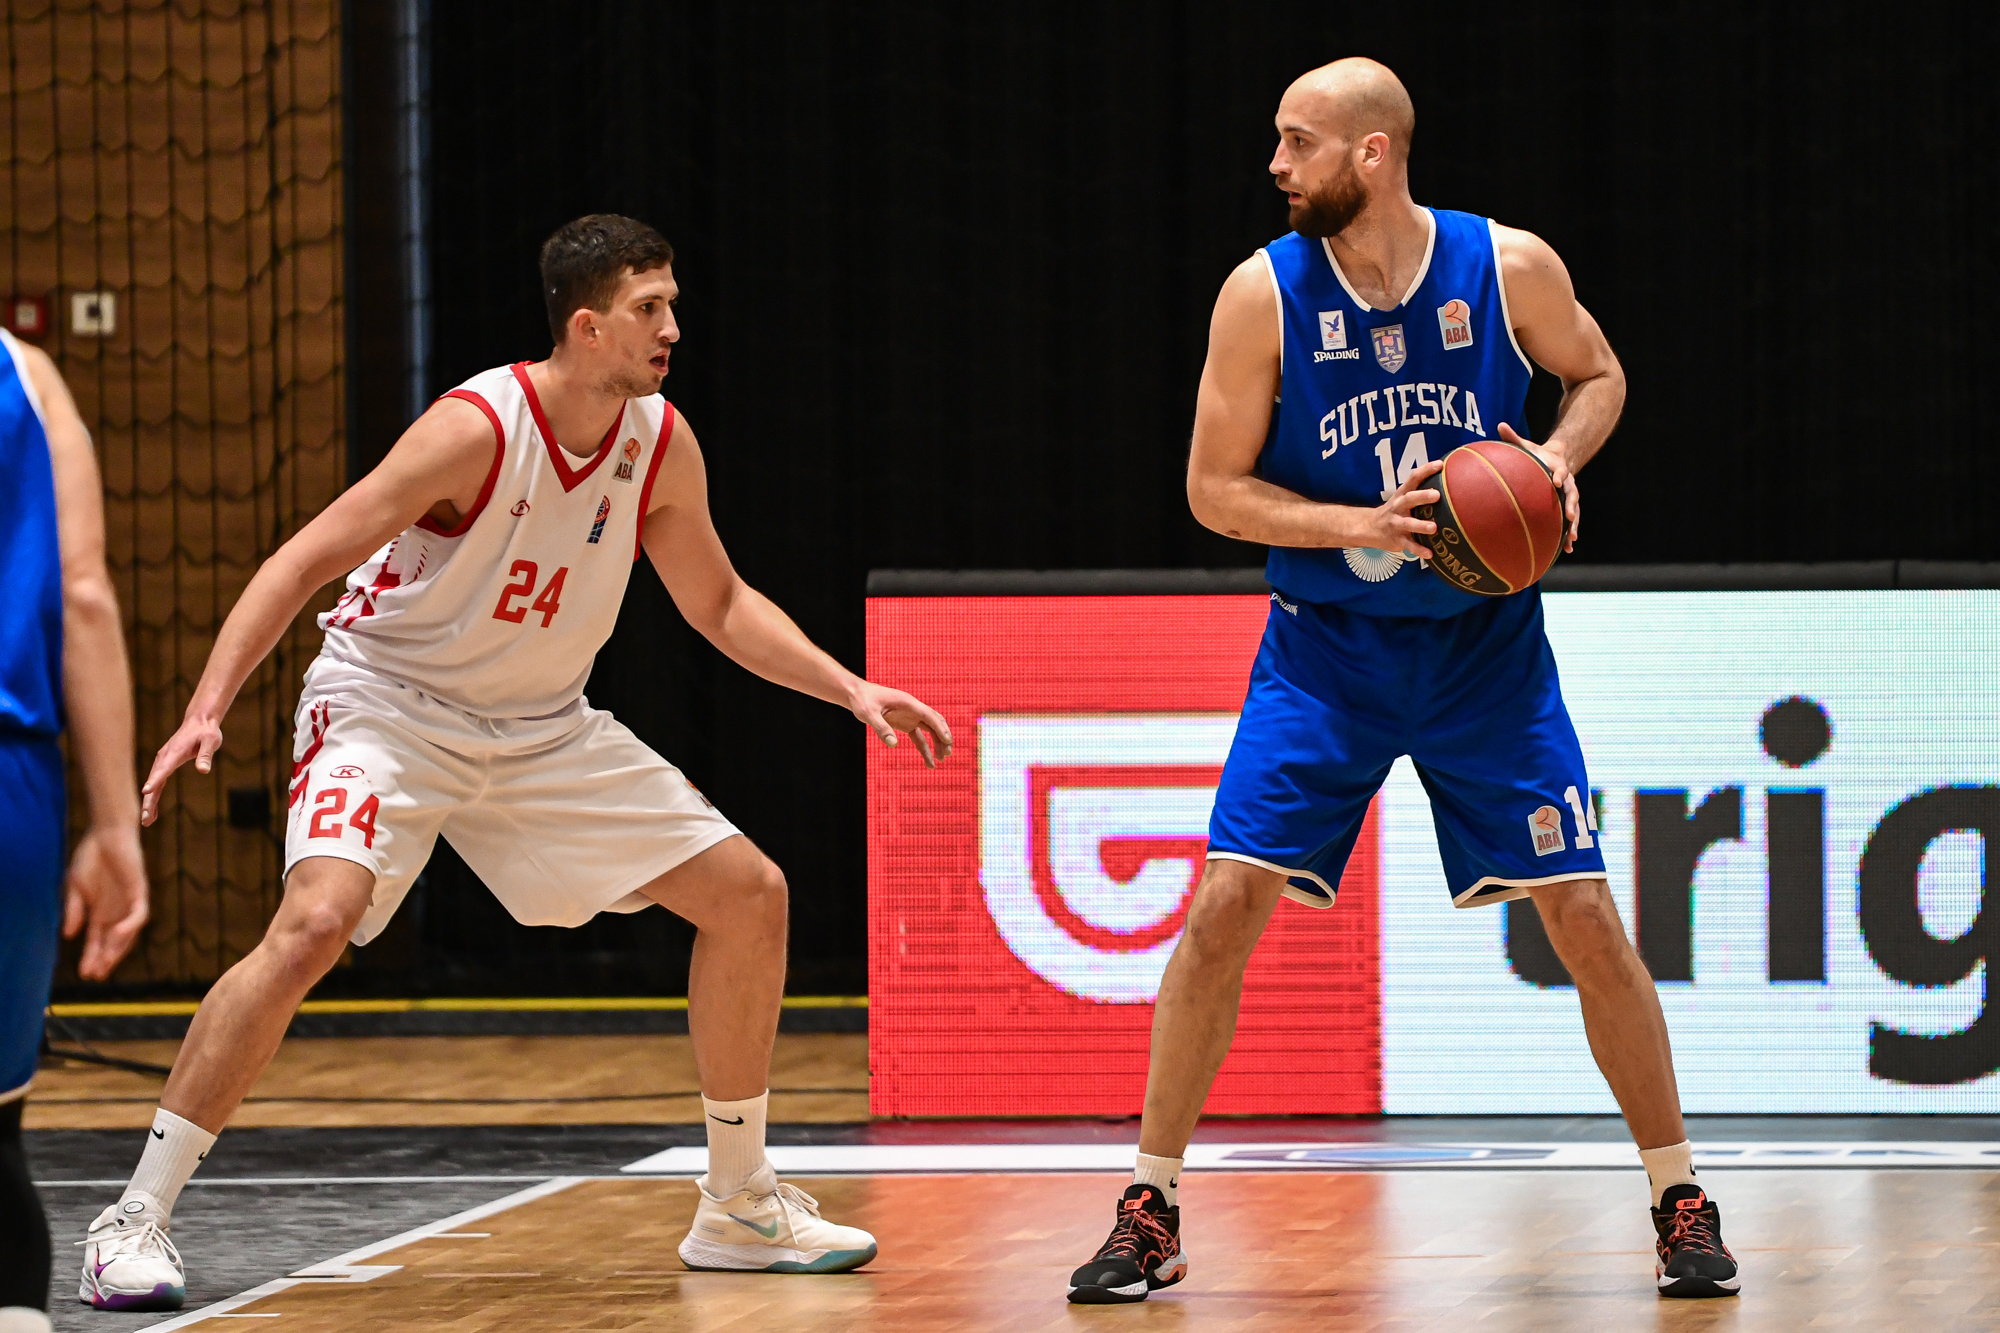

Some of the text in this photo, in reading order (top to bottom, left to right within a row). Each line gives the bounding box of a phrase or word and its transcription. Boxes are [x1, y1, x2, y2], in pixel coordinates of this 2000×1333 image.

[1445, 326, 1469, 344] ABA
[1313, 347, 1360, 363] SPALDING
[1319, 382, 1487, 461] SUTJESKA
[614, 461, 632, 481] ABA
[1374, 431, 1430, 502] 14
[492, 559, 569, 628] 24
[308, 787, 380, 850] 24
[1537, 831, 1562, 851] ABA
[1683, 1200, 1696, 1208] NIKE
